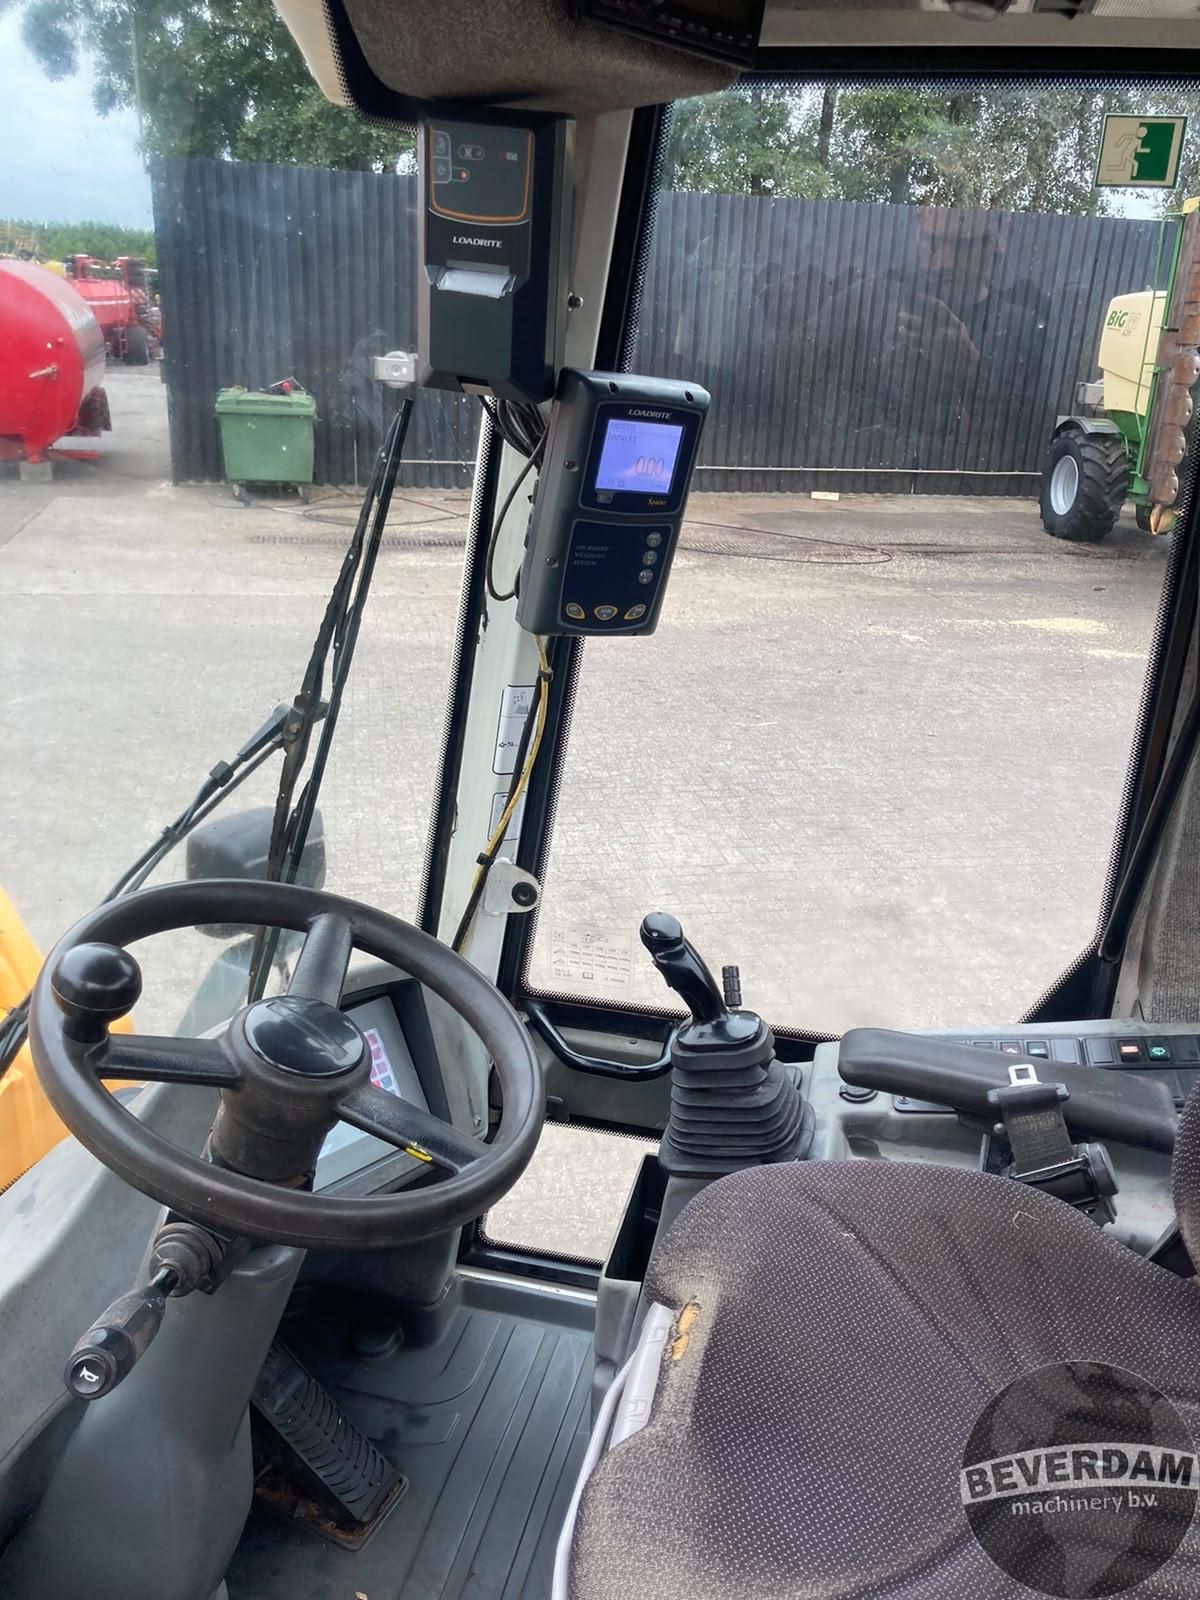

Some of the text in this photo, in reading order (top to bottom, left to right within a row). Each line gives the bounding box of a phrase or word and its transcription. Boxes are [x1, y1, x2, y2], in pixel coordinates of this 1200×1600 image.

[452, 236, 503, 248] LOADRITE
[1107, 310, 1129, 328] BiG
[628, 408, 672, 420] LOADRITE
